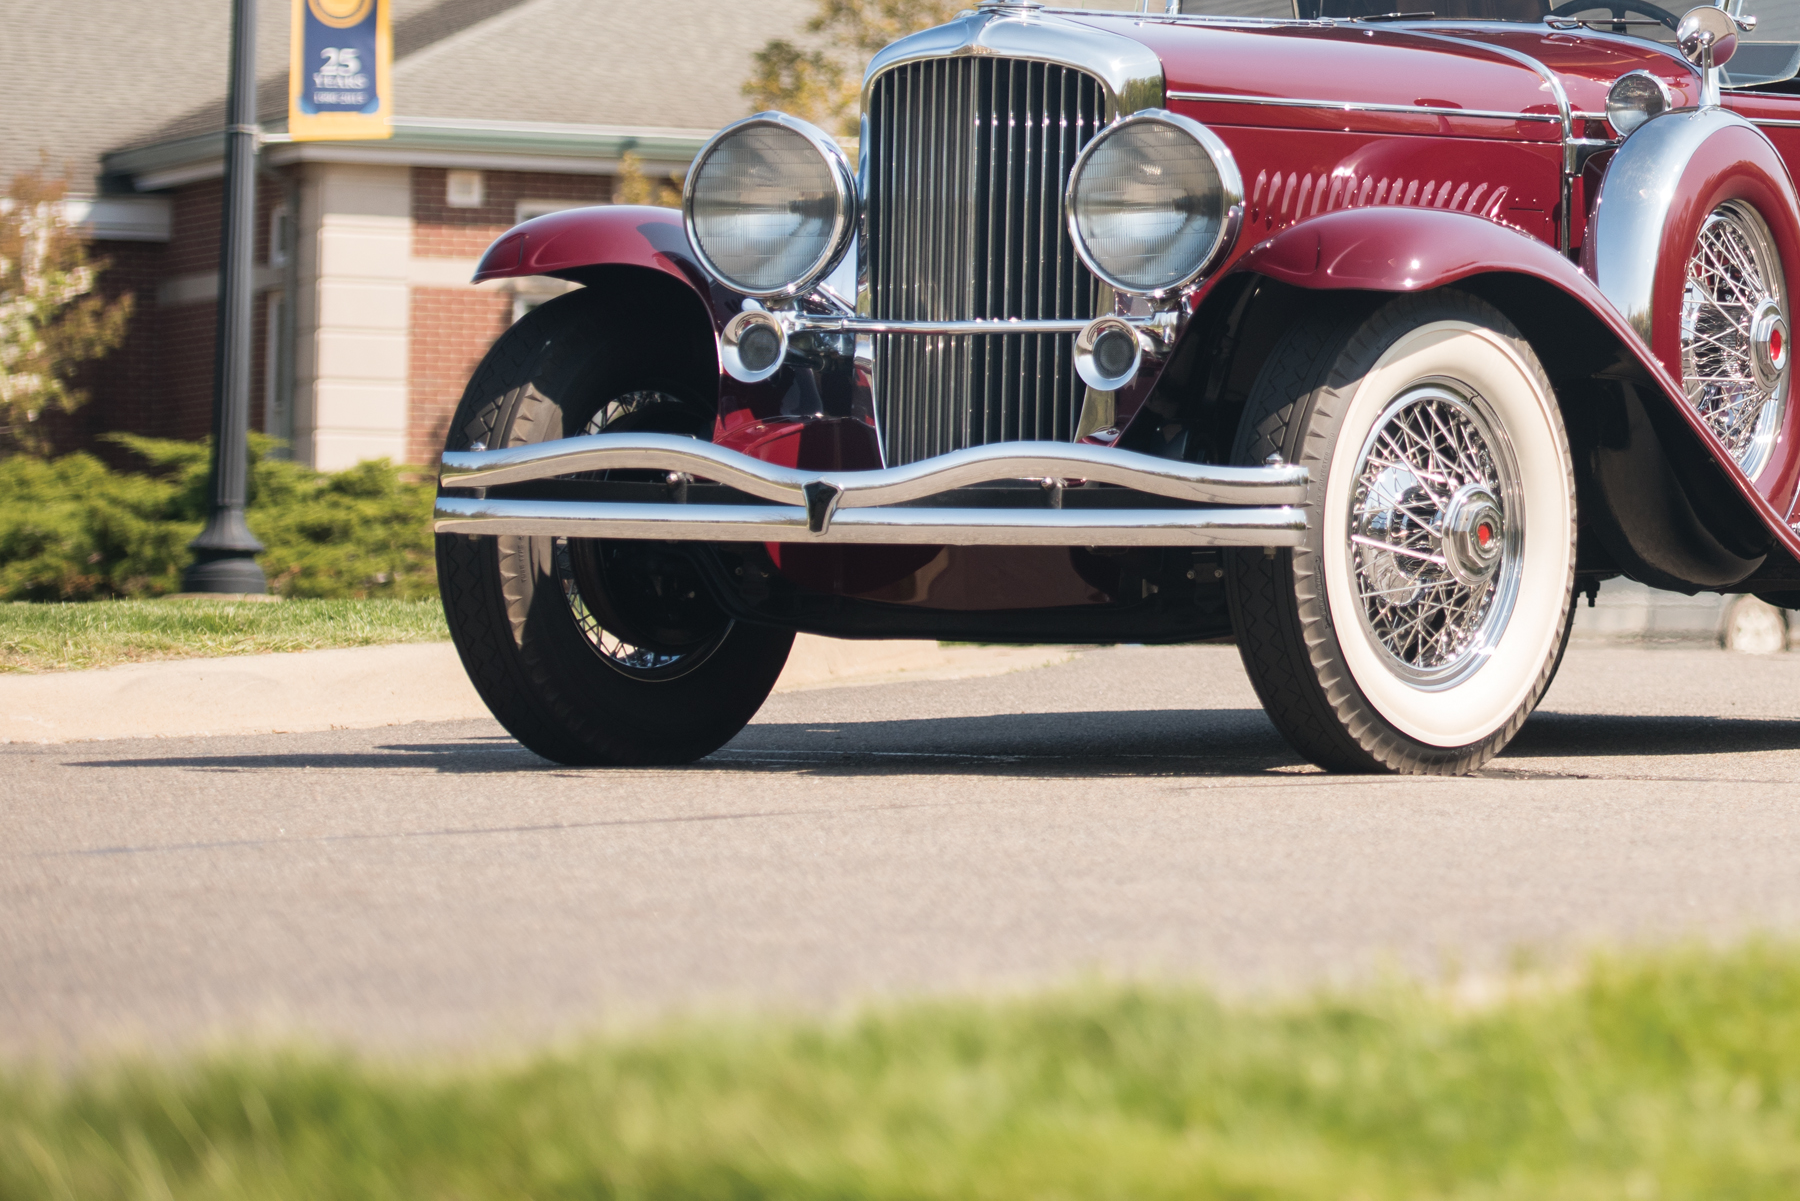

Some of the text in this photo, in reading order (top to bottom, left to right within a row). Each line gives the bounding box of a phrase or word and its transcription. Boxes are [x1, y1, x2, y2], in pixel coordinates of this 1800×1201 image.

[319, 46, 362, 76] 25
[313, 72, 369, 89] YEARS
[1318, 452, 1330, 491] POLYESTER
